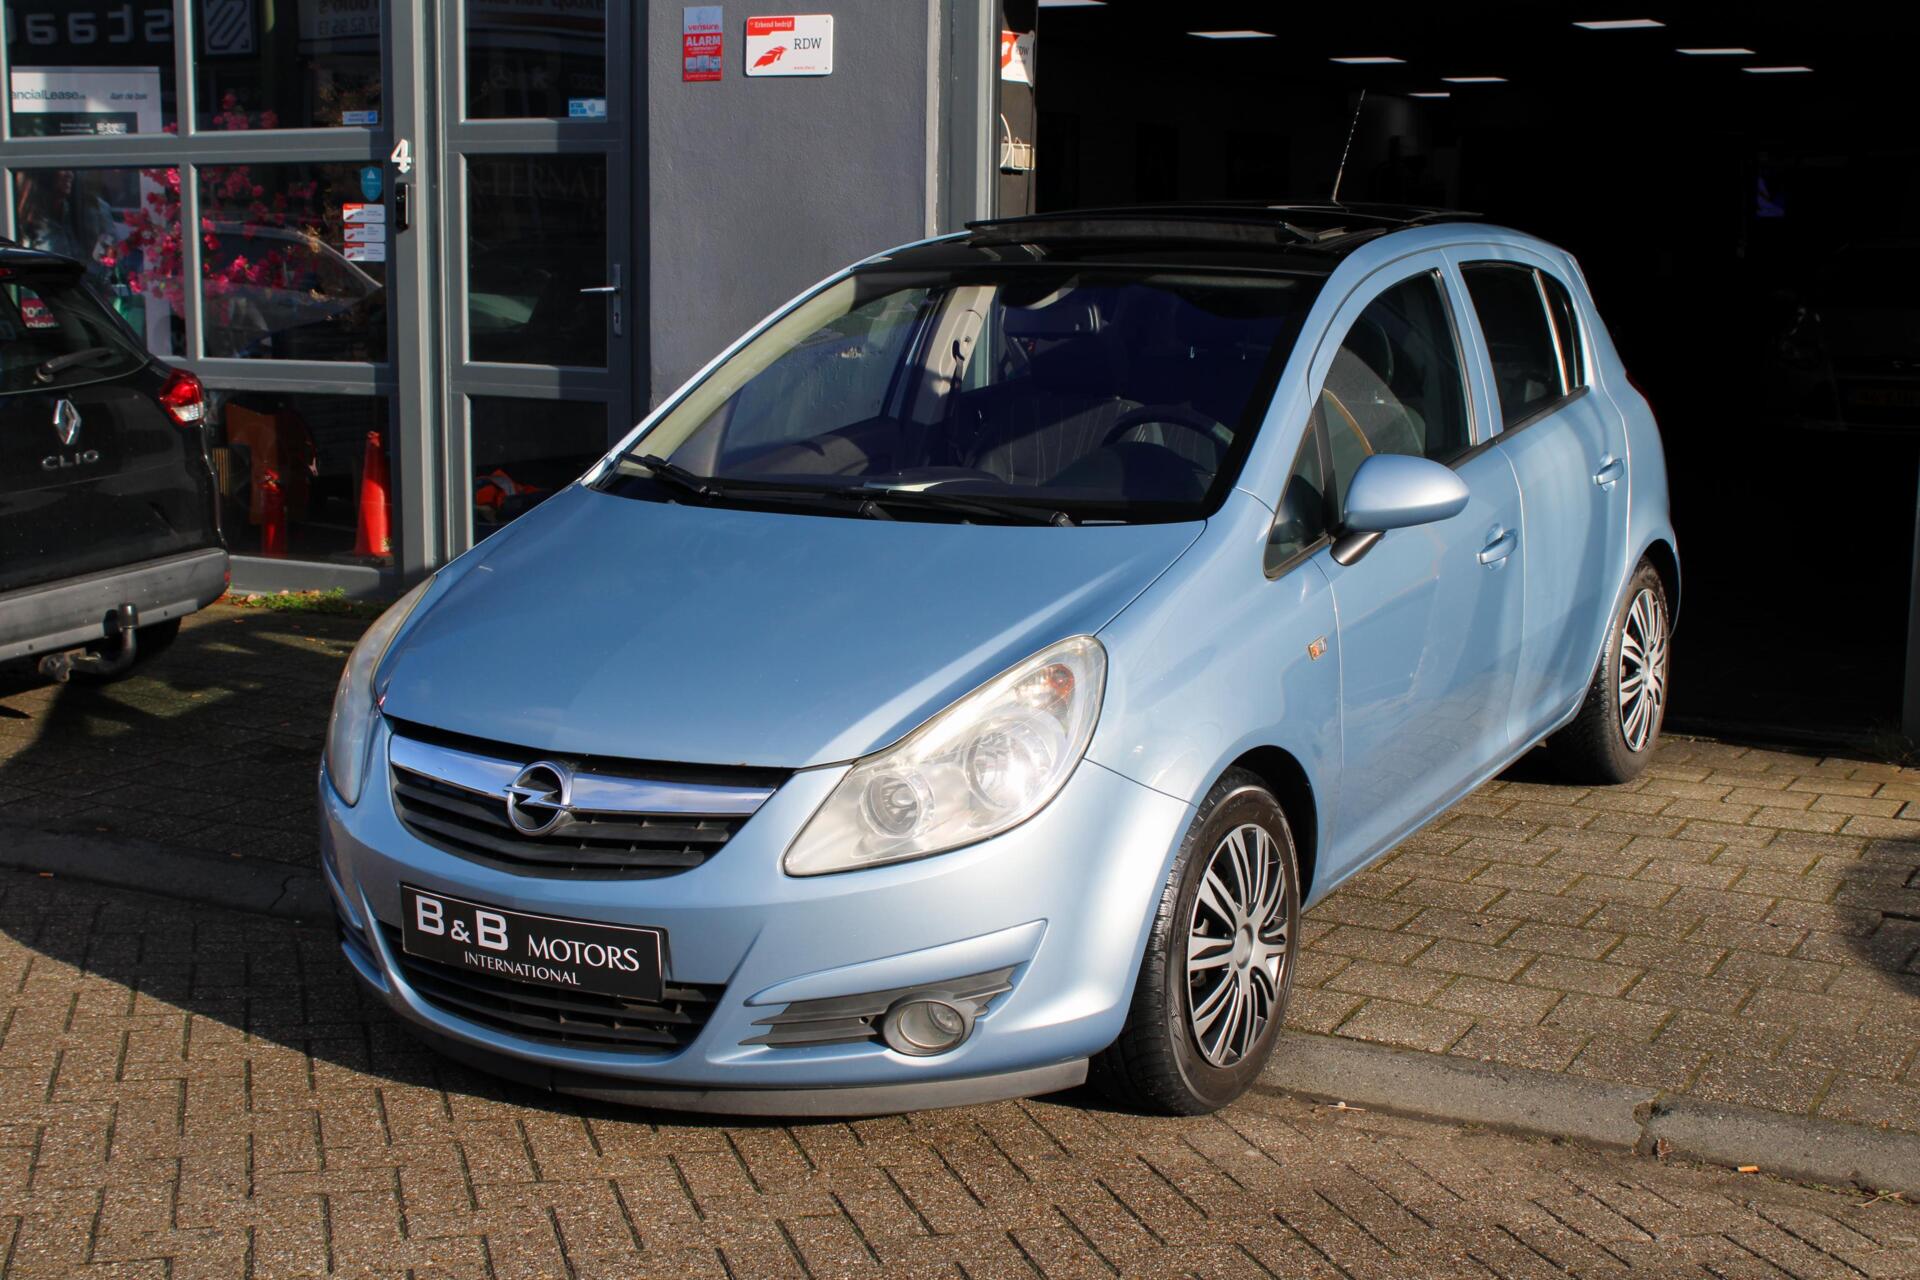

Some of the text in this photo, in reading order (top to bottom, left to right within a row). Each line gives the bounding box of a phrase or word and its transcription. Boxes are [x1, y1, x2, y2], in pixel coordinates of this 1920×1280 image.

[774, 20, 792, 29] bedrijf
[686, 35, 721, 47] ALARM
[794, 37, 822, 50] RDW
[391, 139, 411, 174] 4
[42, 450, 98, 470] CLIO
[528, 934, 640, 972] MOTORS
[464, 951, 581, 985] INTERNATIONAL
